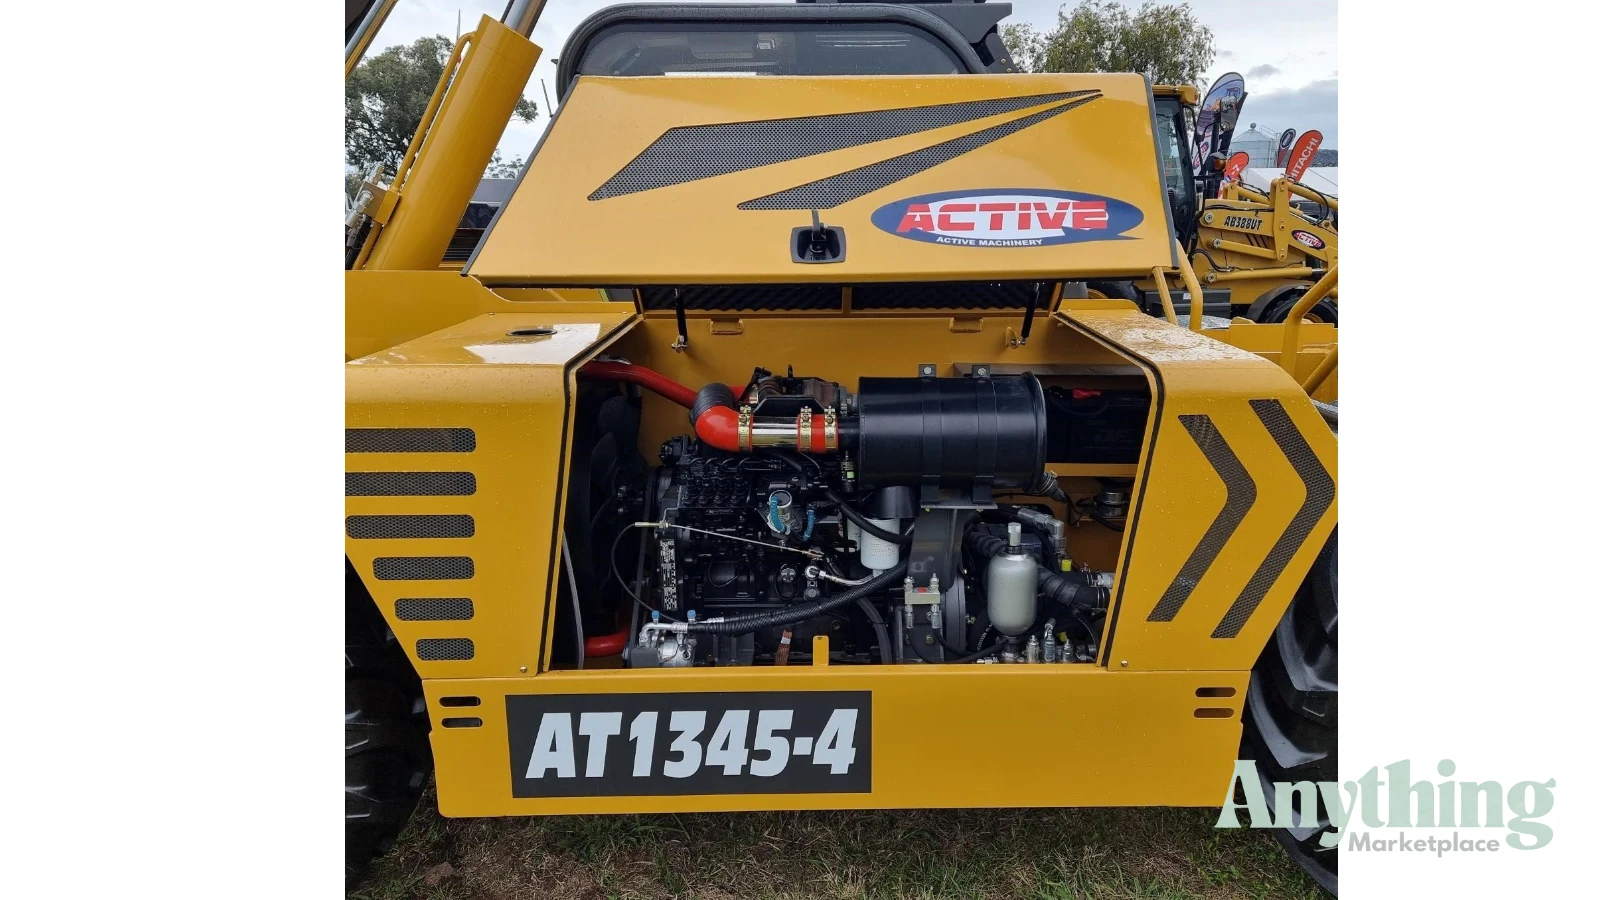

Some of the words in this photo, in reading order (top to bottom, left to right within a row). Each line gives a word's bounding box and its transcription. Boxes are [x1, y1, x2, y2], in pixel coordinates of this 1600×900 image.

[1289, 137, 1320, 181] HITACHI
[896, 200, 1108, 233] ACTIVE
[1224, 215, 1263, 231] AB388UT
[936, 236, 976, 246] ACTIVE
[979, 237, 1043, 247] MACHINERY
[525, 708, 859, 779] AT1345-4
